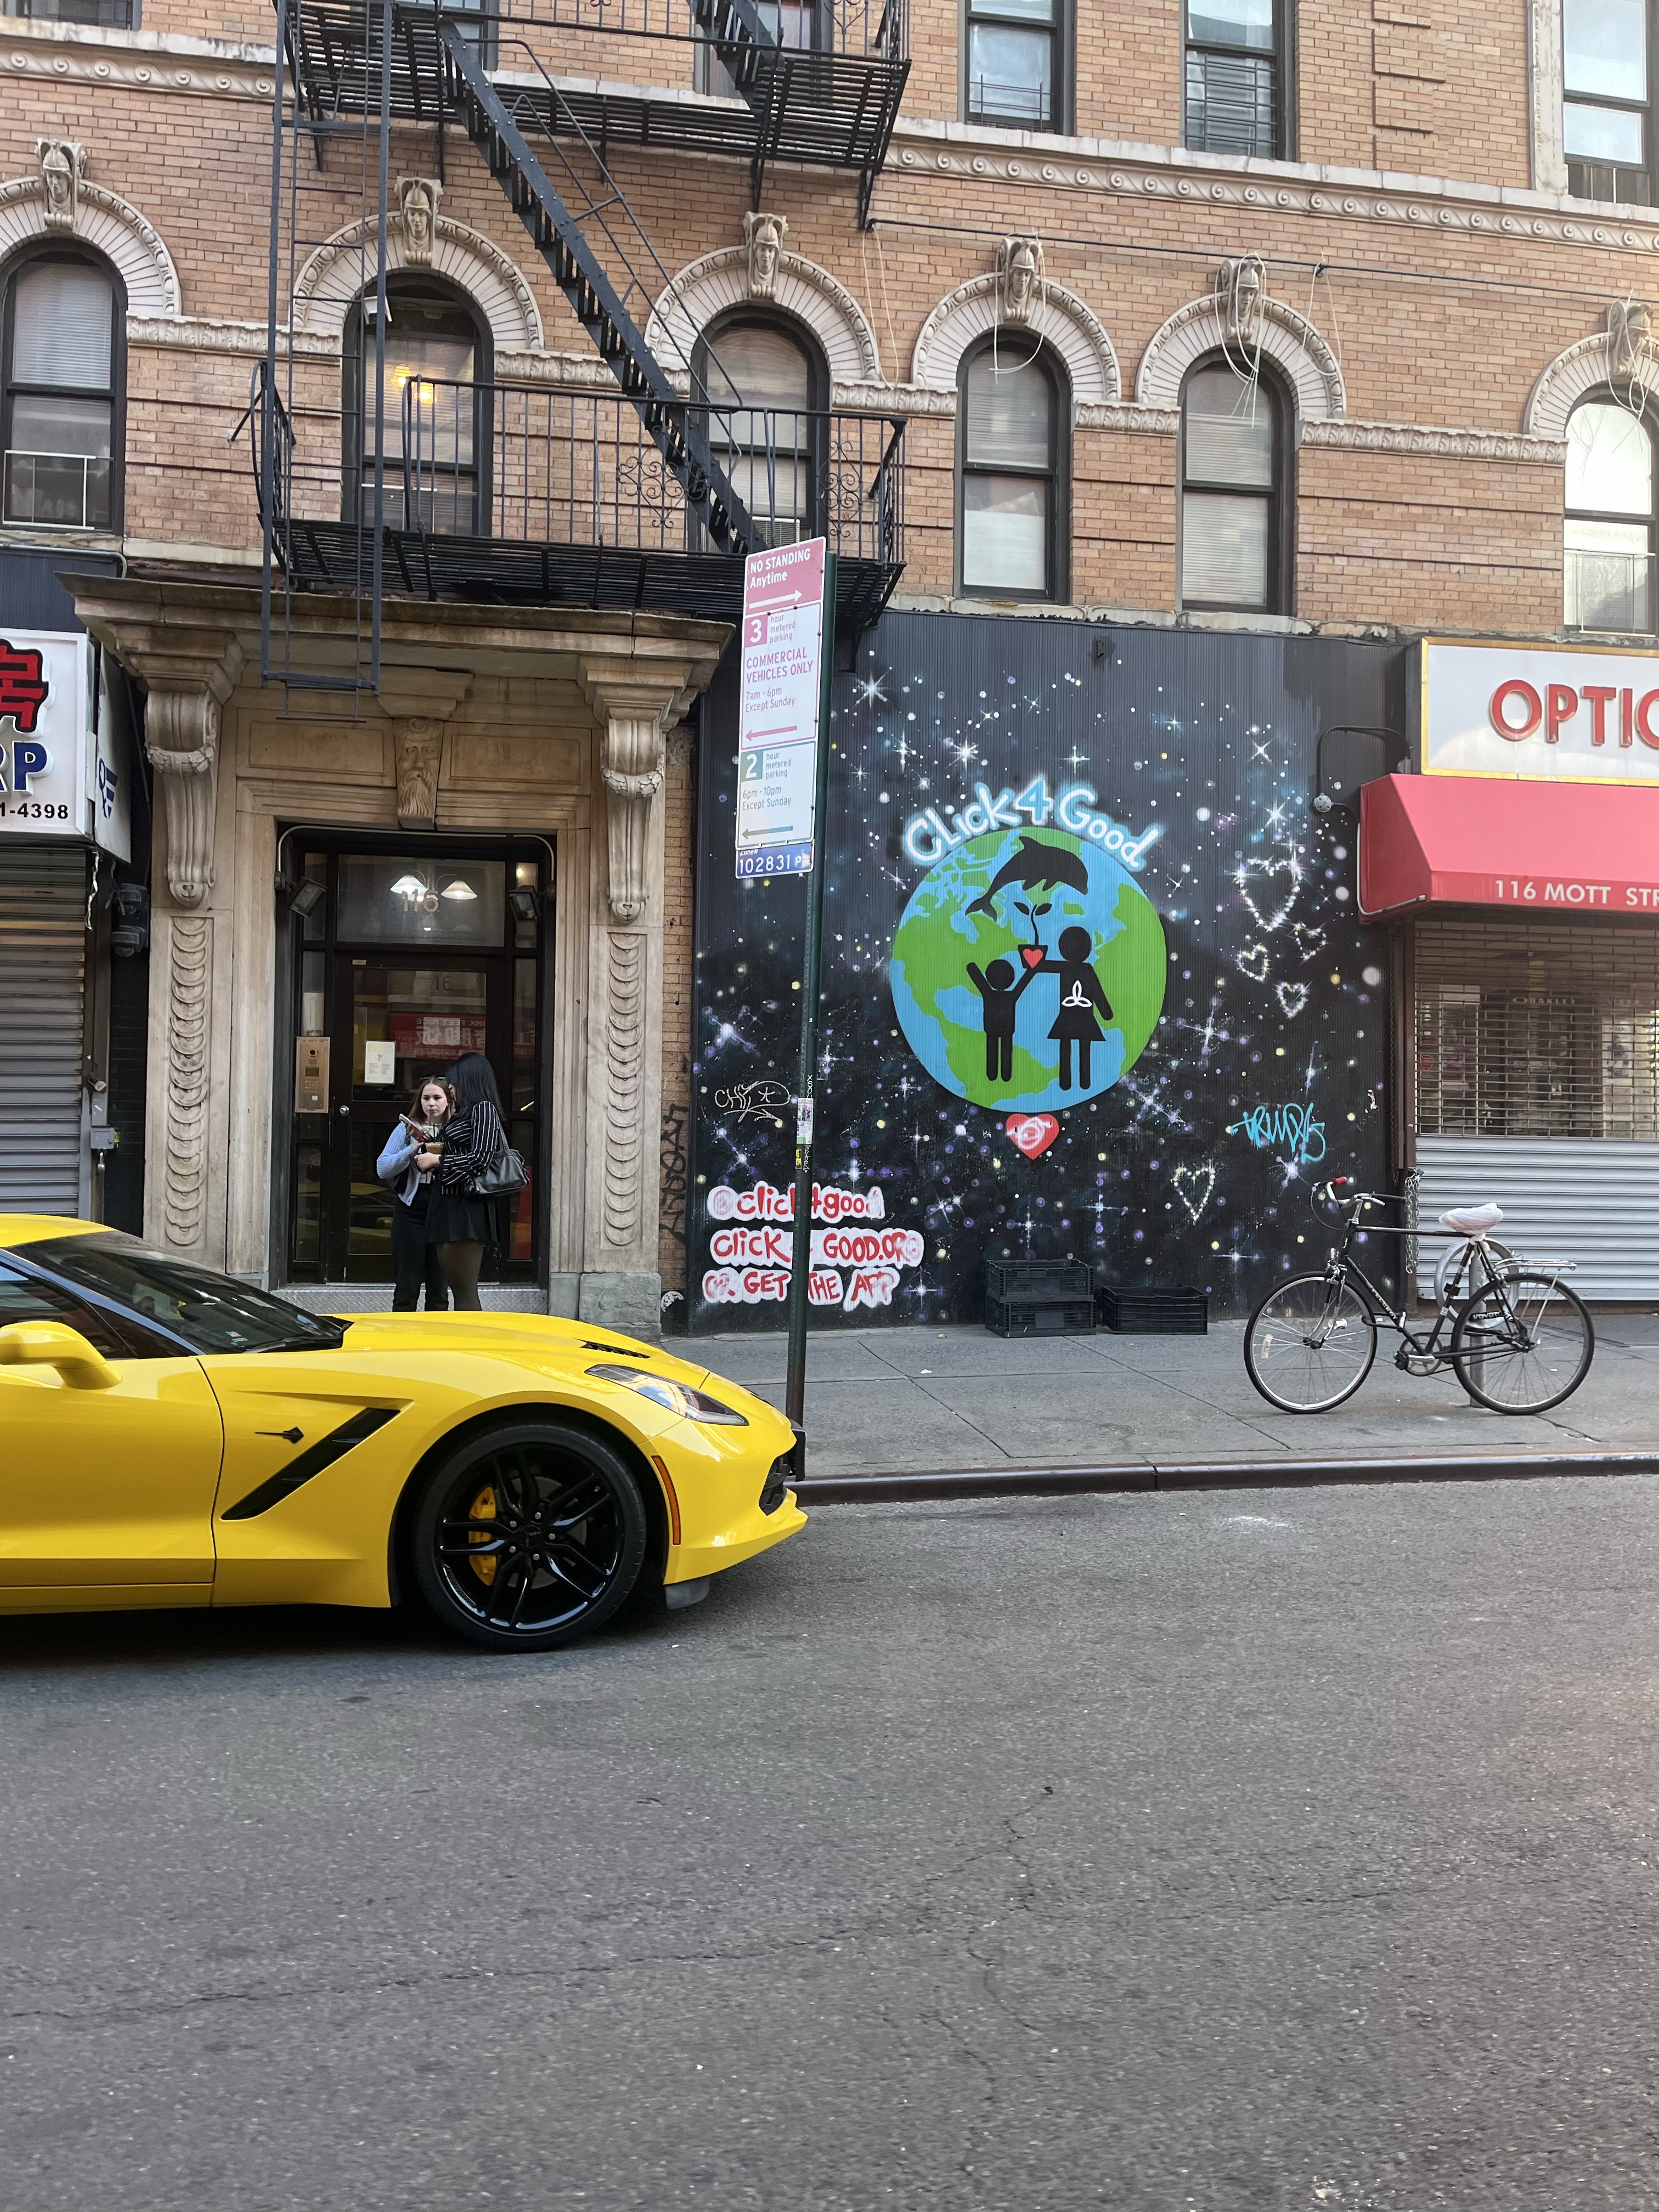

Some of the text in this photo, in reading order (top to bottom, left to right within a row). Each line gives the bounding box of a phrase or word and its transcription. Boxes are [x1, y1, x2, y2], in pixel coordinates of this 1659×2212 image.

[751, 548, 811, 574] NO STANDING
[750, 571, 787, 589] Anytime
[770, 614, 784, 624] hour
[770, 622, 795, 633] metered
[749, 619, 762, 643] 3
[770, 632, 792, 645] parking
[747, 647, 808, 669] COMMERCIAL
[746, 660, 813, 684] VEHICLES ONLY
[746, 691, 760, 701] 7am
[767, 687, 782, 699] 6pm
[745, 696, 795, 713] Except Sunday
[766, 752, 780, 760] hour
[766, 758, 791, 770] metered
[745, 753, 758, 779] 2
[765, 769, 788, 780] parking
[743, 789, 757, 800] 6pm
[764, 786, 781, 797] 10pm
[742, 796, 792, 811] Except Sunday
[740, 854, 791, 874] 102831
[402, 889, 439, 912] 116
[1496, 880, 1537, 900] 116
[1544, 883, 1611, 905] MOTT
[743, 1271, 789, 1298] GET
